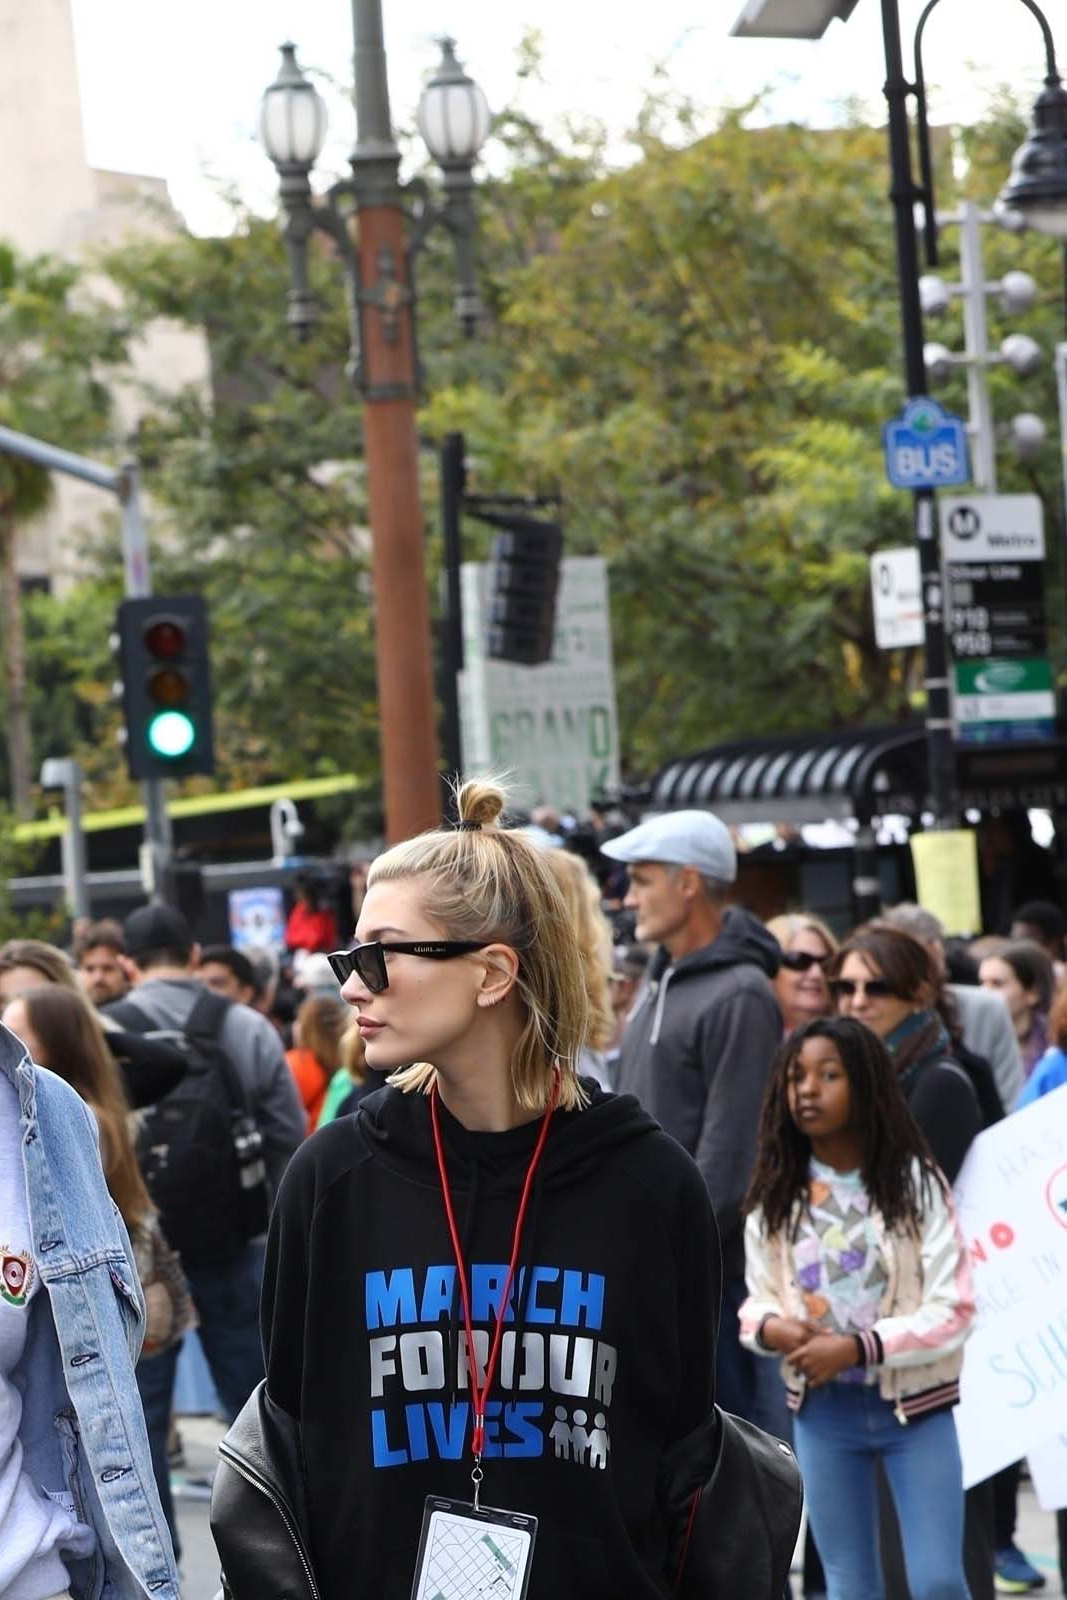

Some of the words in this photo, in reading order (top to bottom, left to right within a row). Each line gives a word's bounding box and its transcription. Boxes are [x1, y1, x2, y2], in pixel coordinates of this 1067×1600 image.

[897, 443, 959, 479] BUS
[365, 1263, 606, 1331] MARCH
[369, 1330, 490, 1398] FOR
[500, 1331, 618, 1408] OUR
[371, 1401, 544, 1468] LIVES
